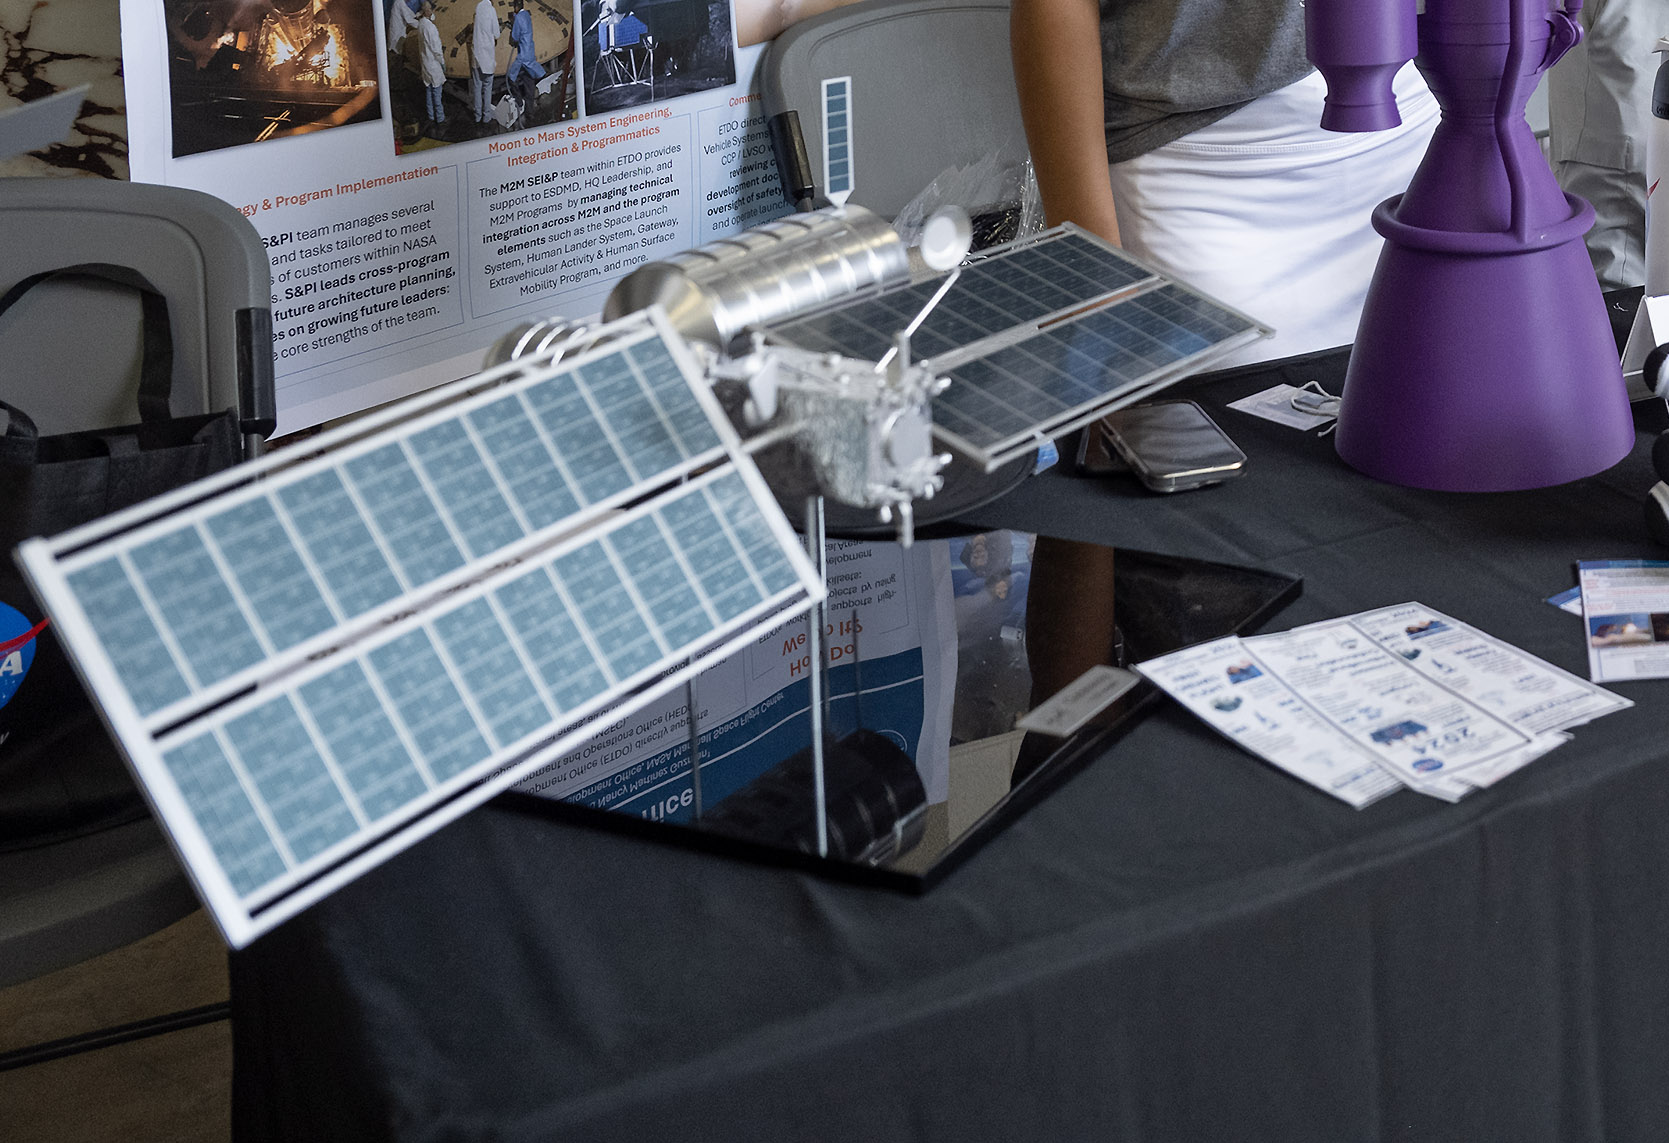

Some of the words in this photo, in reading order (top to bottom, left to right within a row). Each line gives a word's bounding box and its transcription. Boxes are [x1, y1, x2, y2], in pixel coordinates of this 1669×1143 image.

[488, 139, 521, 154] Moon
[523, 137, 535, 146] to
[537, 130, 565, 143] Mars
[567, 121, 607, 138] System
[609, 107, 672, 127] Engineering,
[507, 146, 568, 167] Integration
[571, 142, 579, 152] &
[581, 126, 660, 150] Programmatics
[262, 199, 272, 210] &
[276, 188, 332, 207] Program
[336, 166, 438, 195] Implementation
[285, 282, 316, 299] S&PI
[320, 274, 355, 290] leads
[359, 251, 449, 280] cross-program
